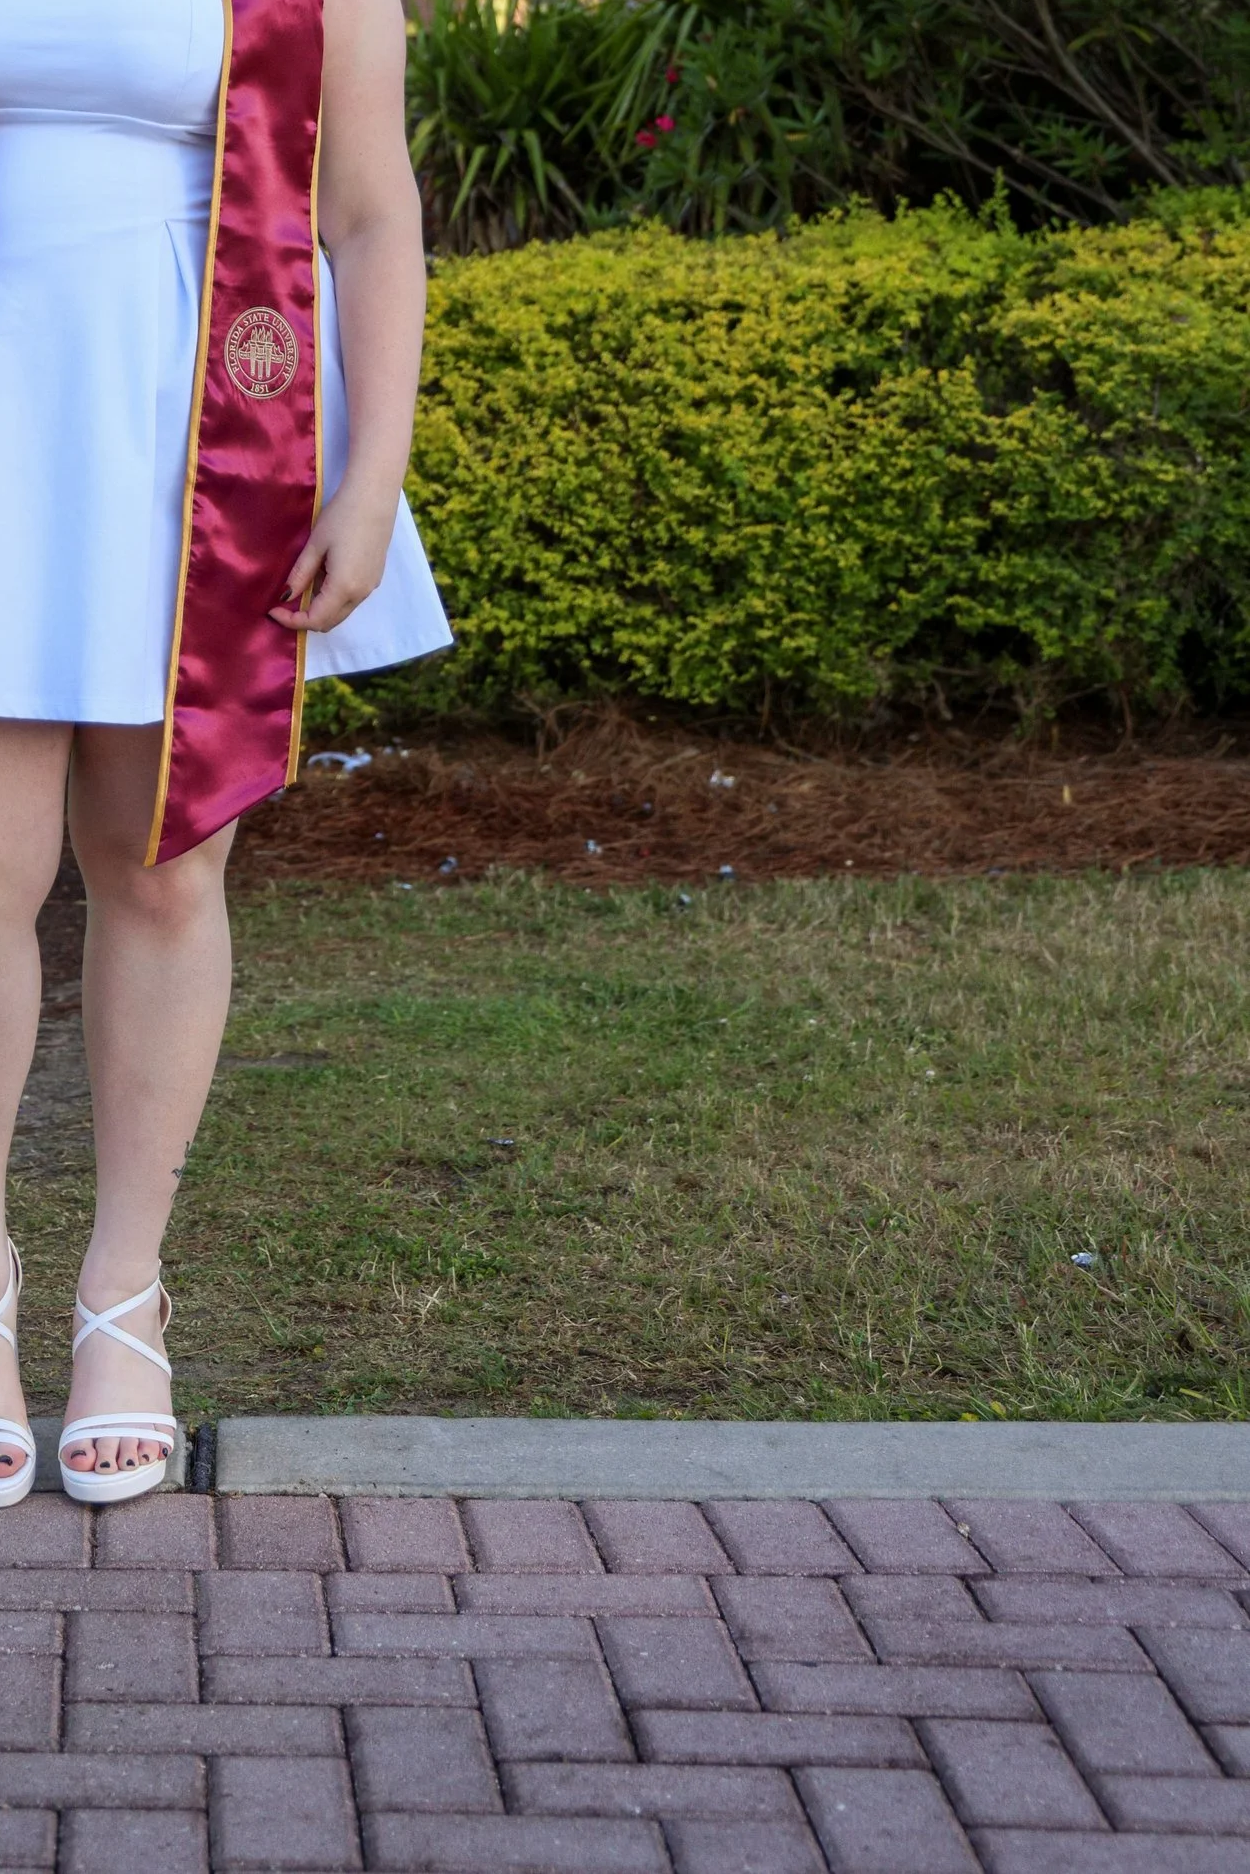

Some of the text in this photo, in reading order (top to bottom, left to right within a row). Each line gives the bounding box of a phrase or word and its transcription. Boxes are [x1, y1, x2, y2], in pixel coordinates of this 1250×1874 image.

[228, 312, 295, 380] FLORIDA STATE UNIVERSITY
[250, 382, 270, 394] 1851
